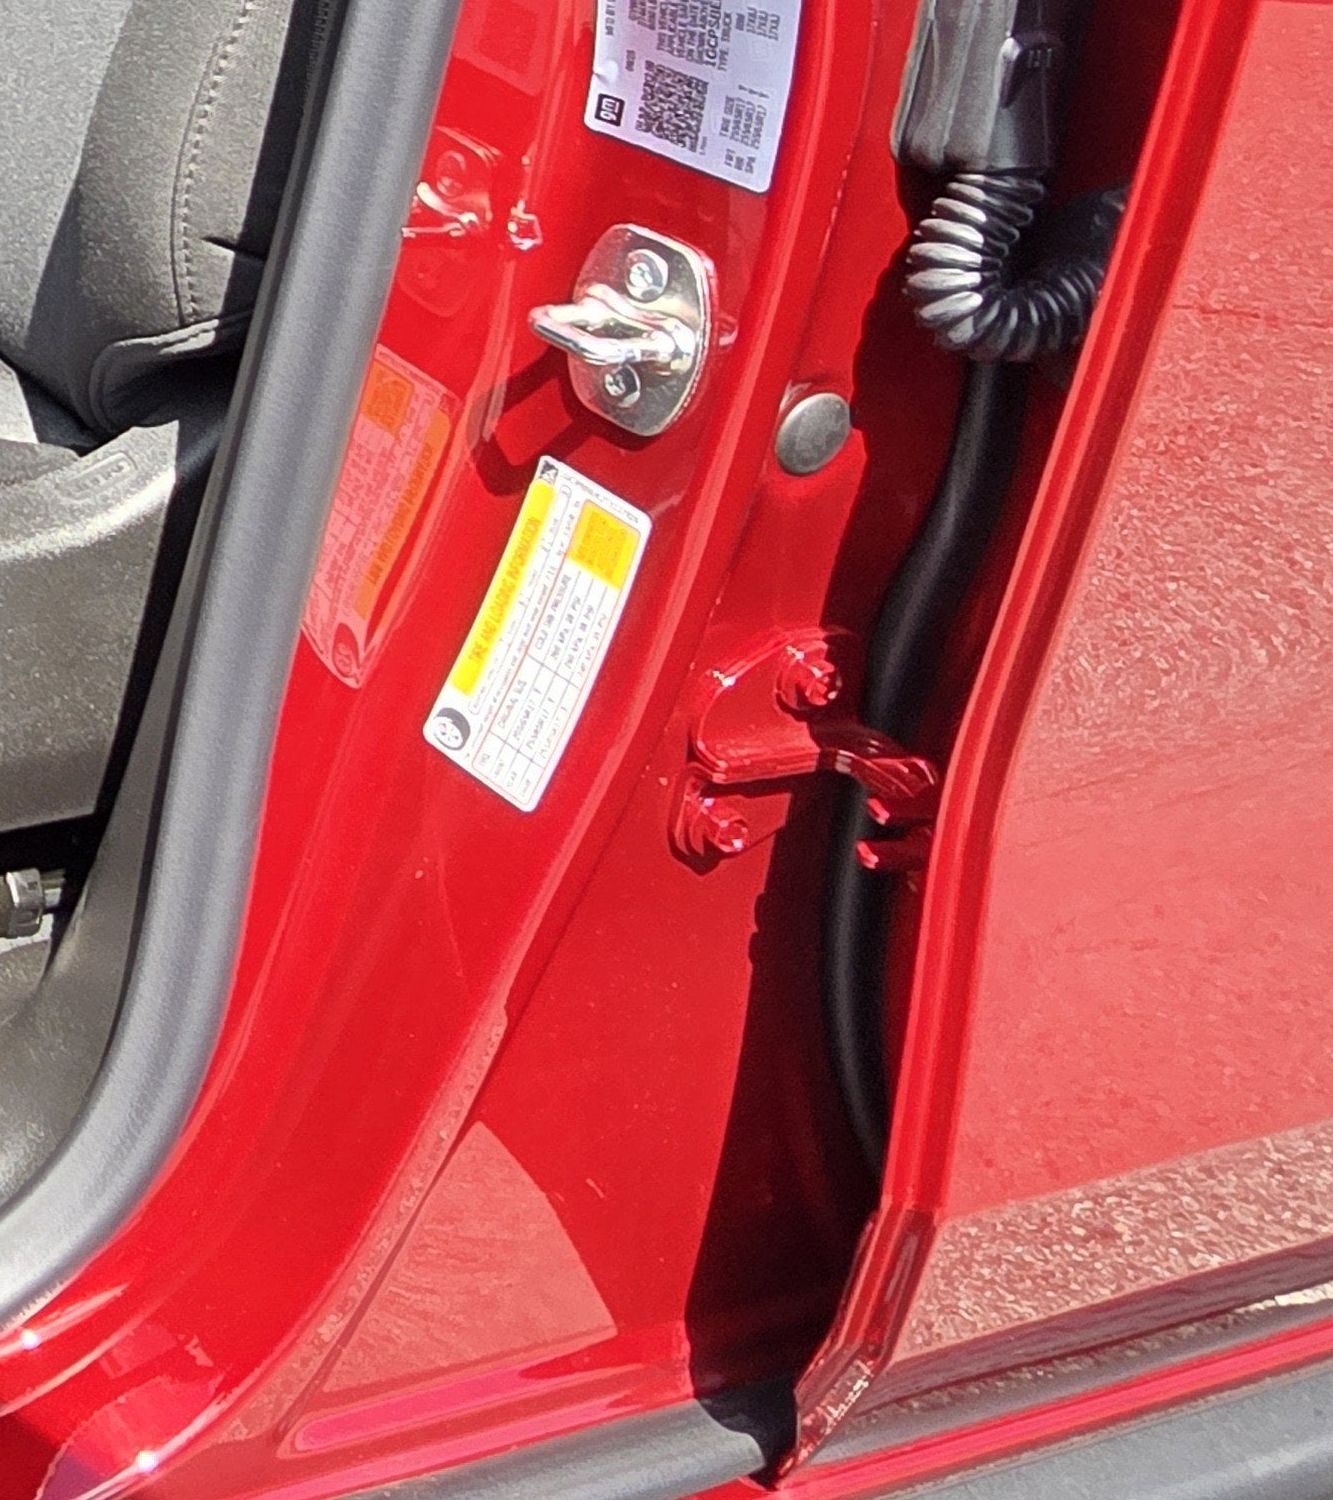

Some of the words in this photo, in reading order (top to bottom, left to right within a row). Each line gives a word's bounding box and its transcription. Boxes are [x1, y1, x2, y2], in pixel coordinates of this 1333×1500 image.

[721, 12, 731, 42] TRUCK
[600, 98, 619, 120] gm
[479, 620, 496, 641] AND
[488, 578, 515, 622] LOADING
[505, 515, 541, 580] INFORMATION
